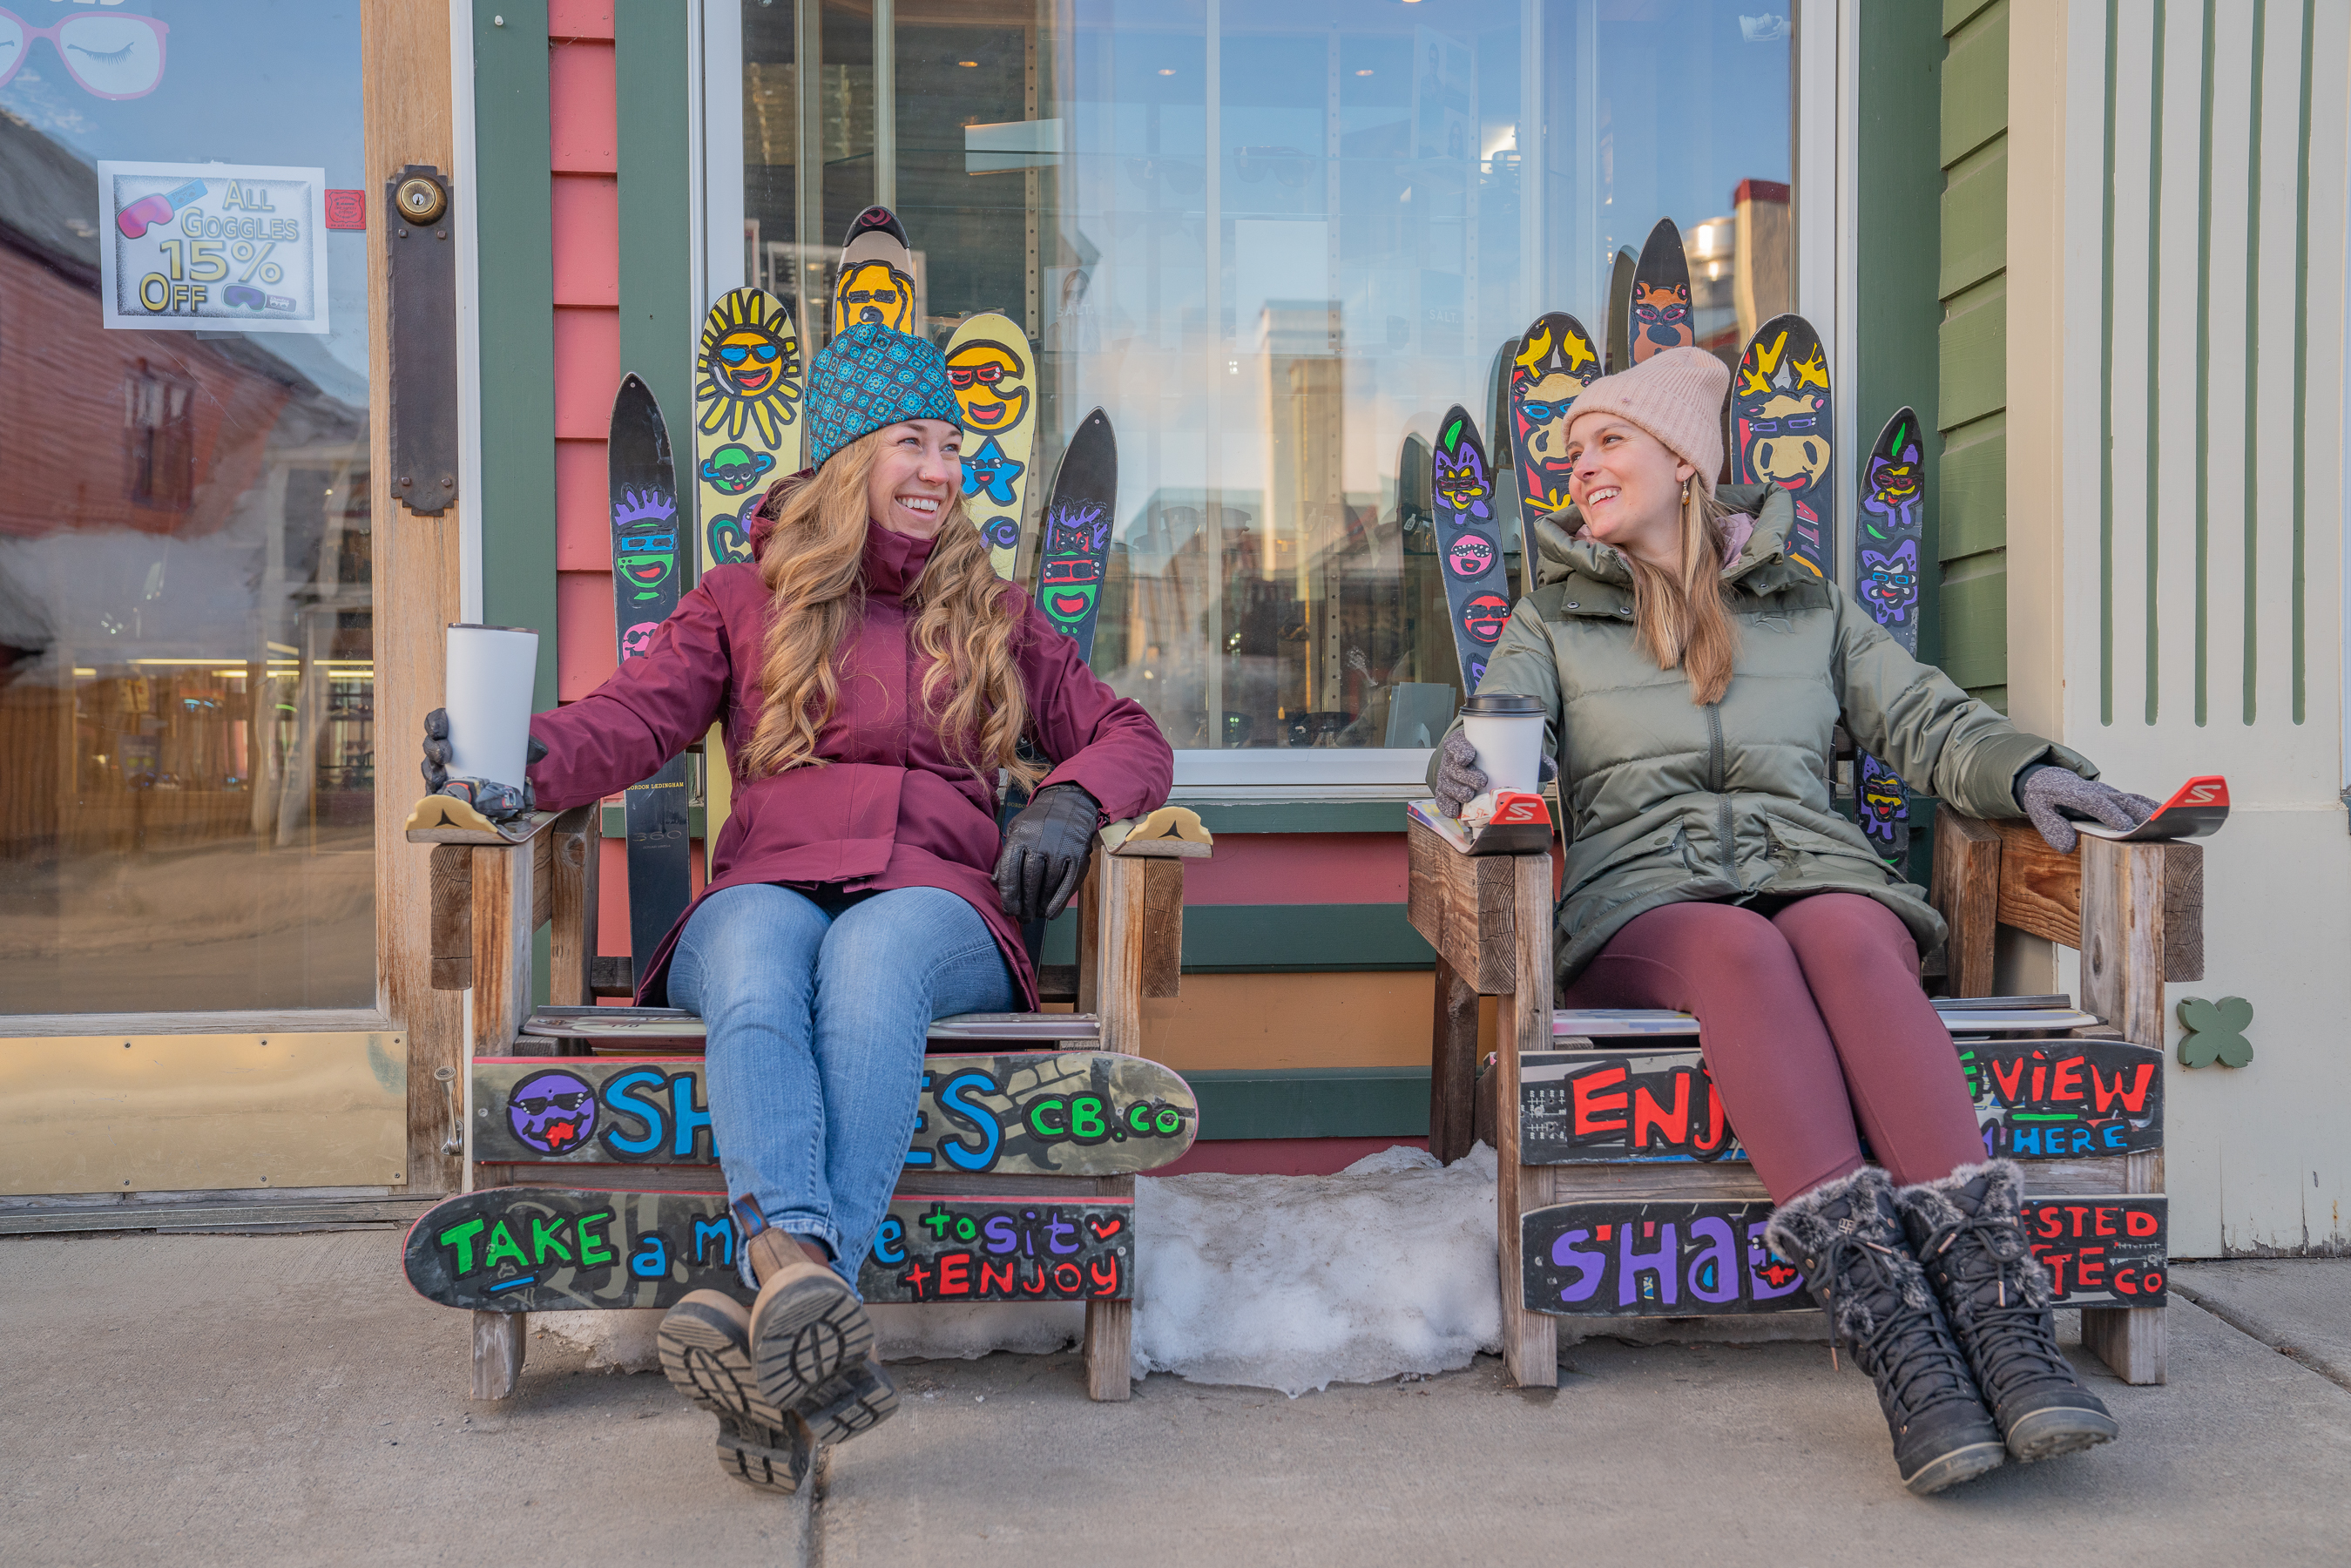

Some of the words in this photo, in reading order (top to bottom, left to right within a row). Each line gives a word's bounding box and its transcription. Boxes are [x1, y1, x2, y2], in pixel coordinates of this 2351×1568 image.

[223, 180, 275, 212] ALL
[181, 206, 300, 242] GOGGLES
[159, 239, 284, 283] 15%
[139, 272, 207, 312] OFF
[1571, 1066, 1726, 1151] ENJ
[2012, 1125, 2128, 1155] HERE
[440, 1212, 613, 1276] TAKE
[632, 1236, 666, 1277] a
